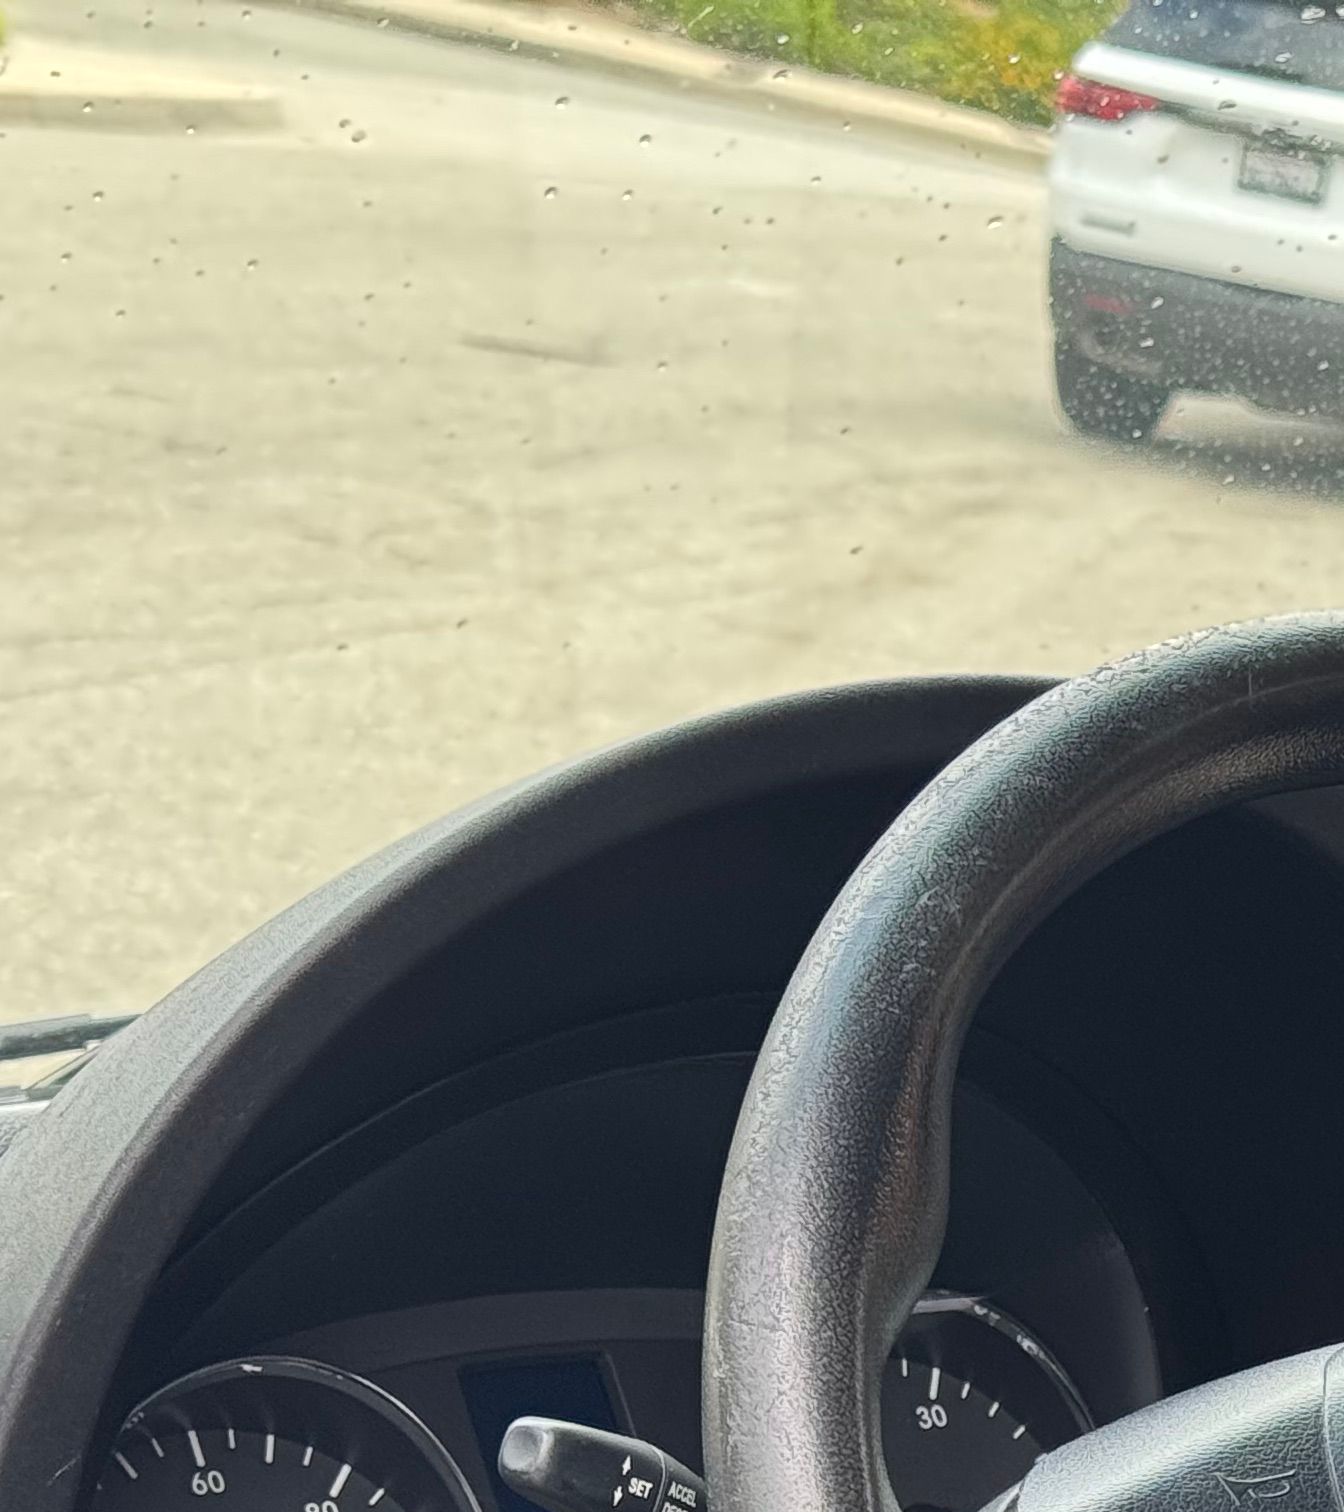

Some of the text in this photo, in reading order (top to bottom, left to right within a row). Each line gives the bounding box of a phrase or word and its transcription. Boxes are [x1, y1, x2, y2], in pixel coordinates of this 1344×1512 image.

[915, 1403, 948, 1430] 30
[191, 1470, 226, 1496] 60
[628, 1477, 654, 1499] SET
[667, 1481, 697, 1508] ACCEL
